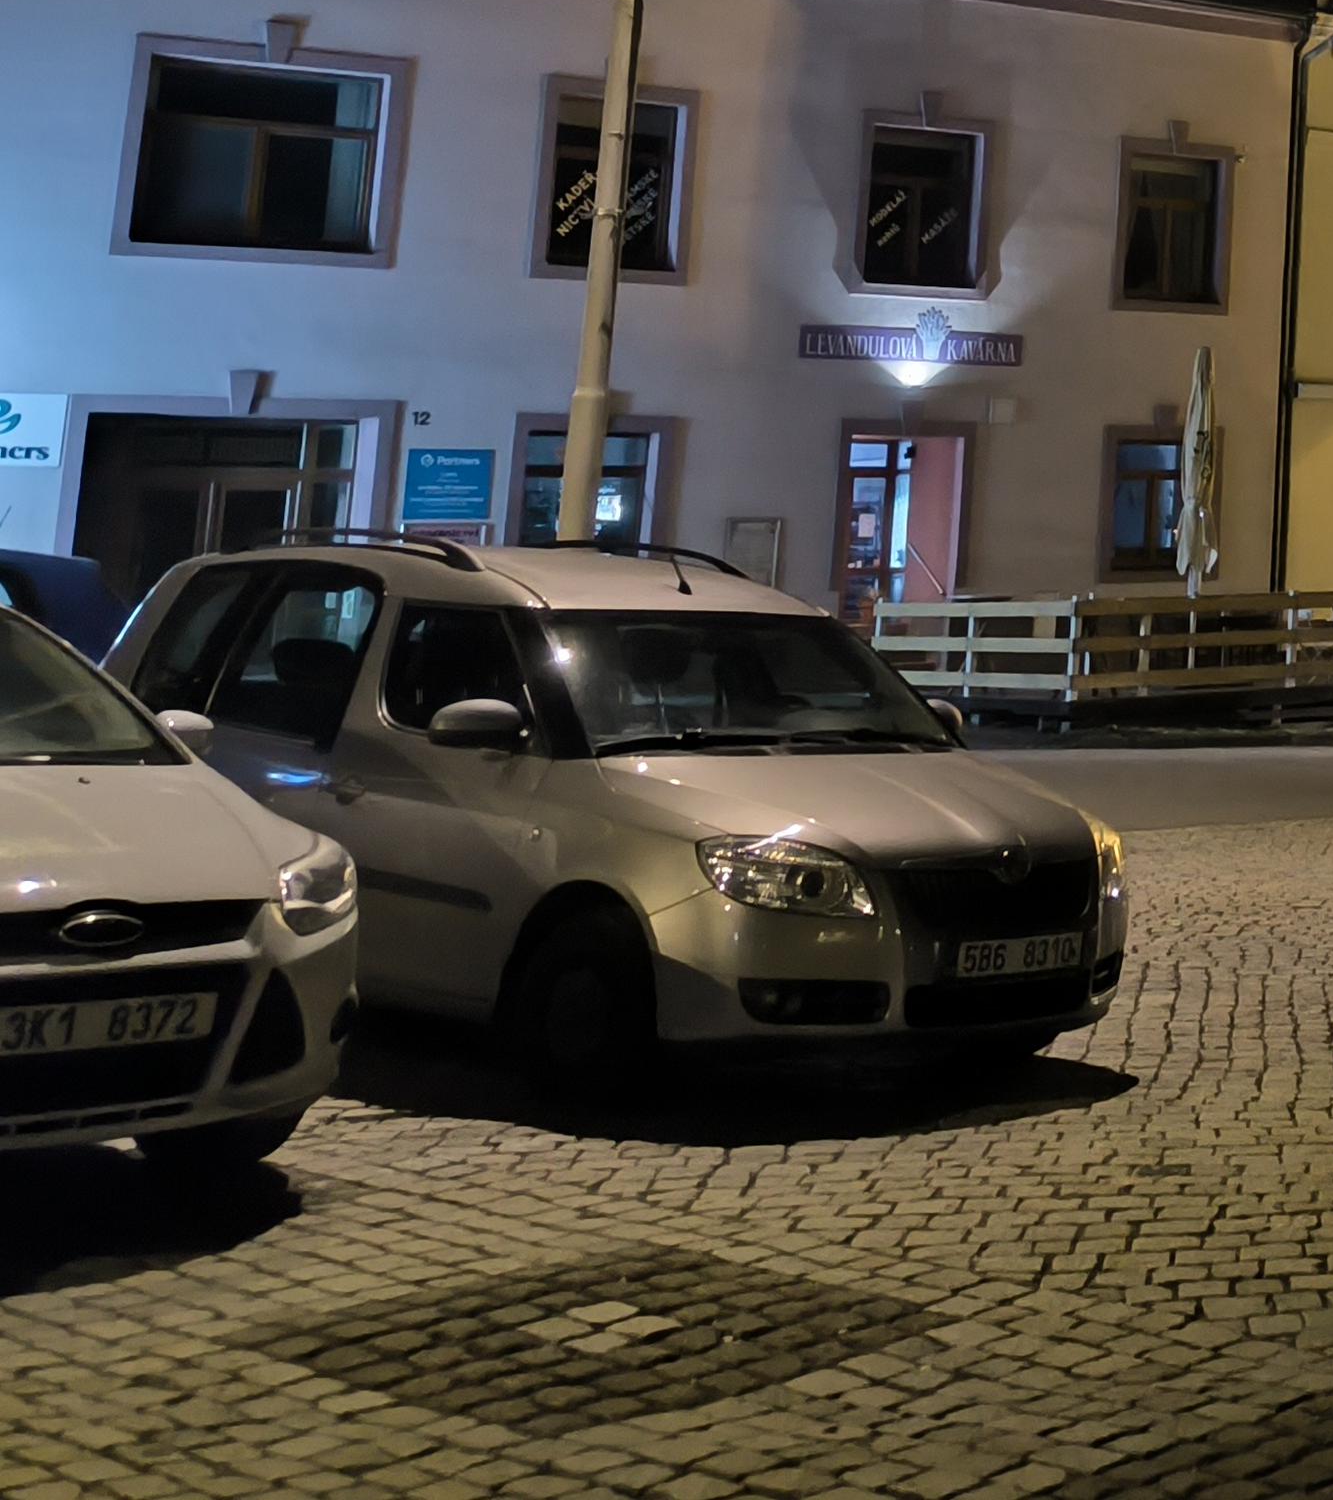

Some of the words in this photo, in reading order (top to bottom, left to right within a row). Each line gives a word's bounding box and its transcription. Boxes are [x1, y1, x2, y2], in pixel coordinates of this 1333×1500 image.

[805, 332, 919, 360] LEVANDULOVÁ
[945, 336, 1016, 363] KAVÁRNA
[412, 411, 431, 426] 12
[436, 455, 481, 466] Partners
[1, 1005, 78, 1050] 3K1
[106, 997, 198, 1042] 8372
